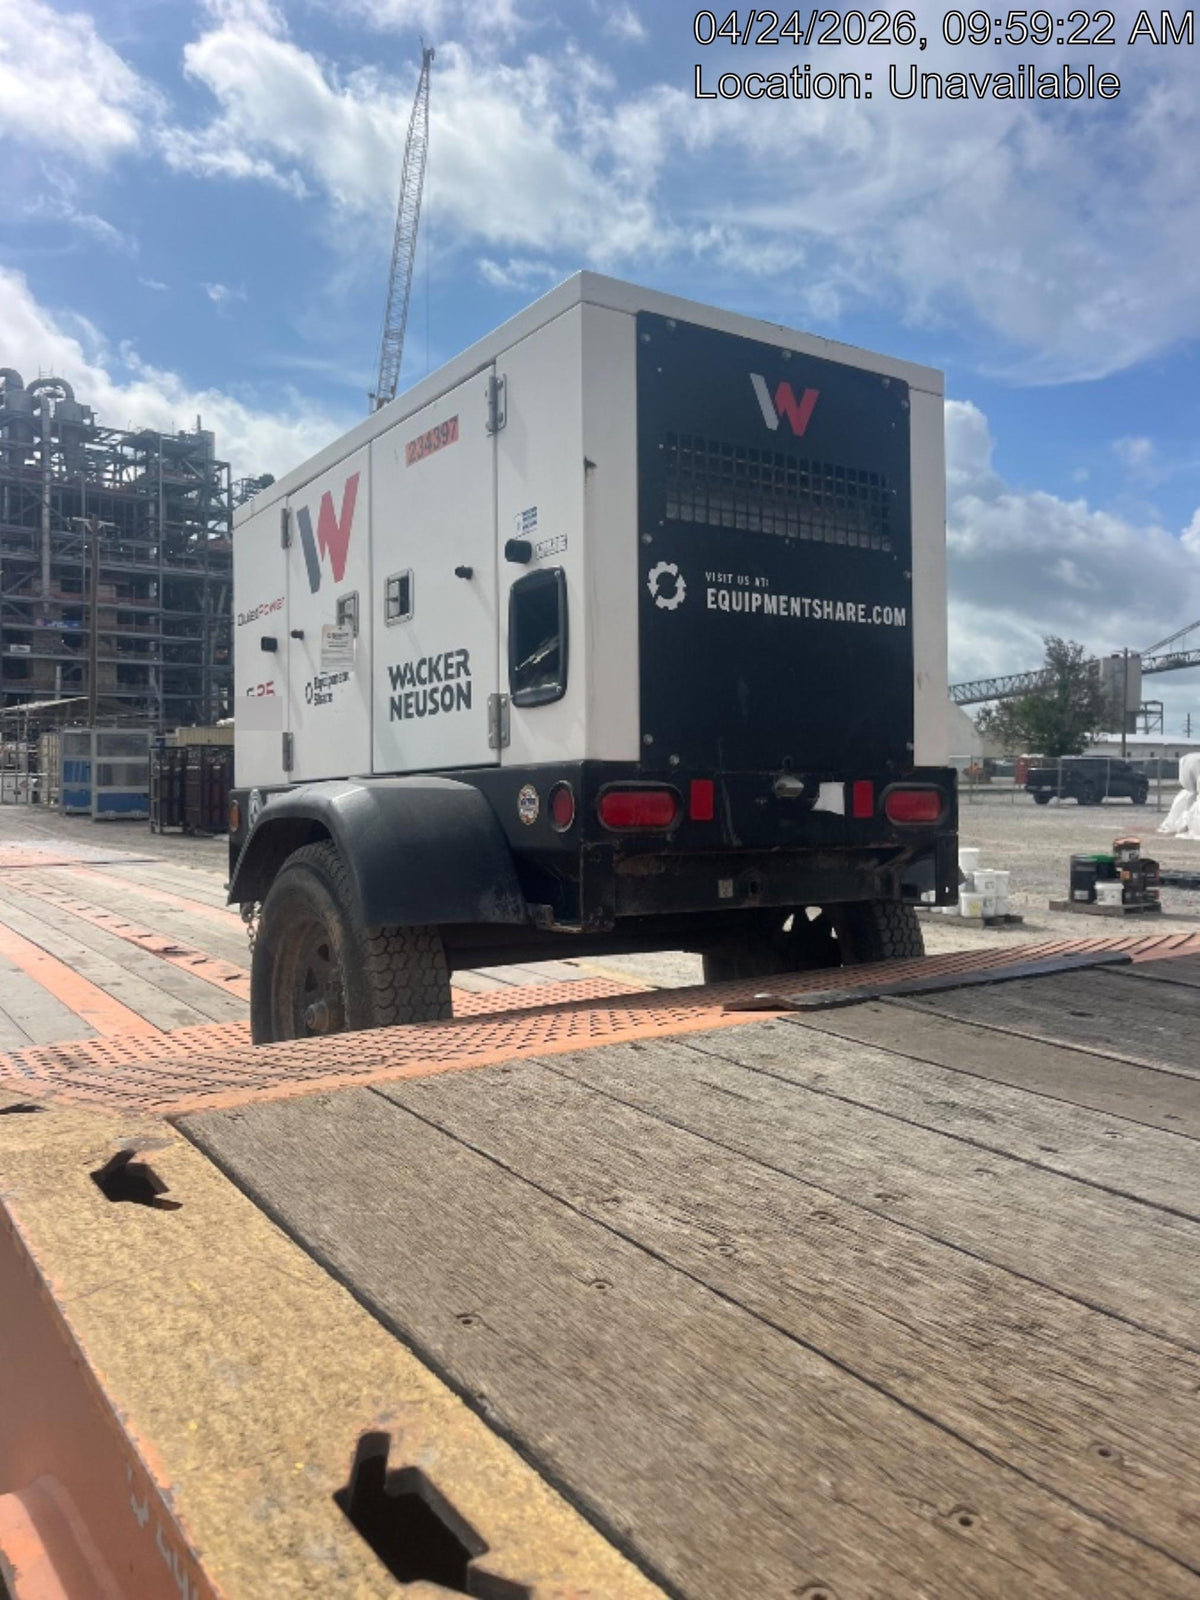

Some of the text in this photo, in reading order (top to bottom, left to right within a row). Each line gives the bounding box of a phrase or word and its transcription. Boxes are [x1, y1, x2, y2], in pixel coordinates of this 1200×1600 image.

[406, 414, 458, 466] 234397
[705, 571, 769, 588] VISIT US AT:
[706, 588, 907, 627] EQUIPMENTSHARE.COM
[387, 648, 472, 692] WACKER
[389, 680, 472, 722] NEUSON
